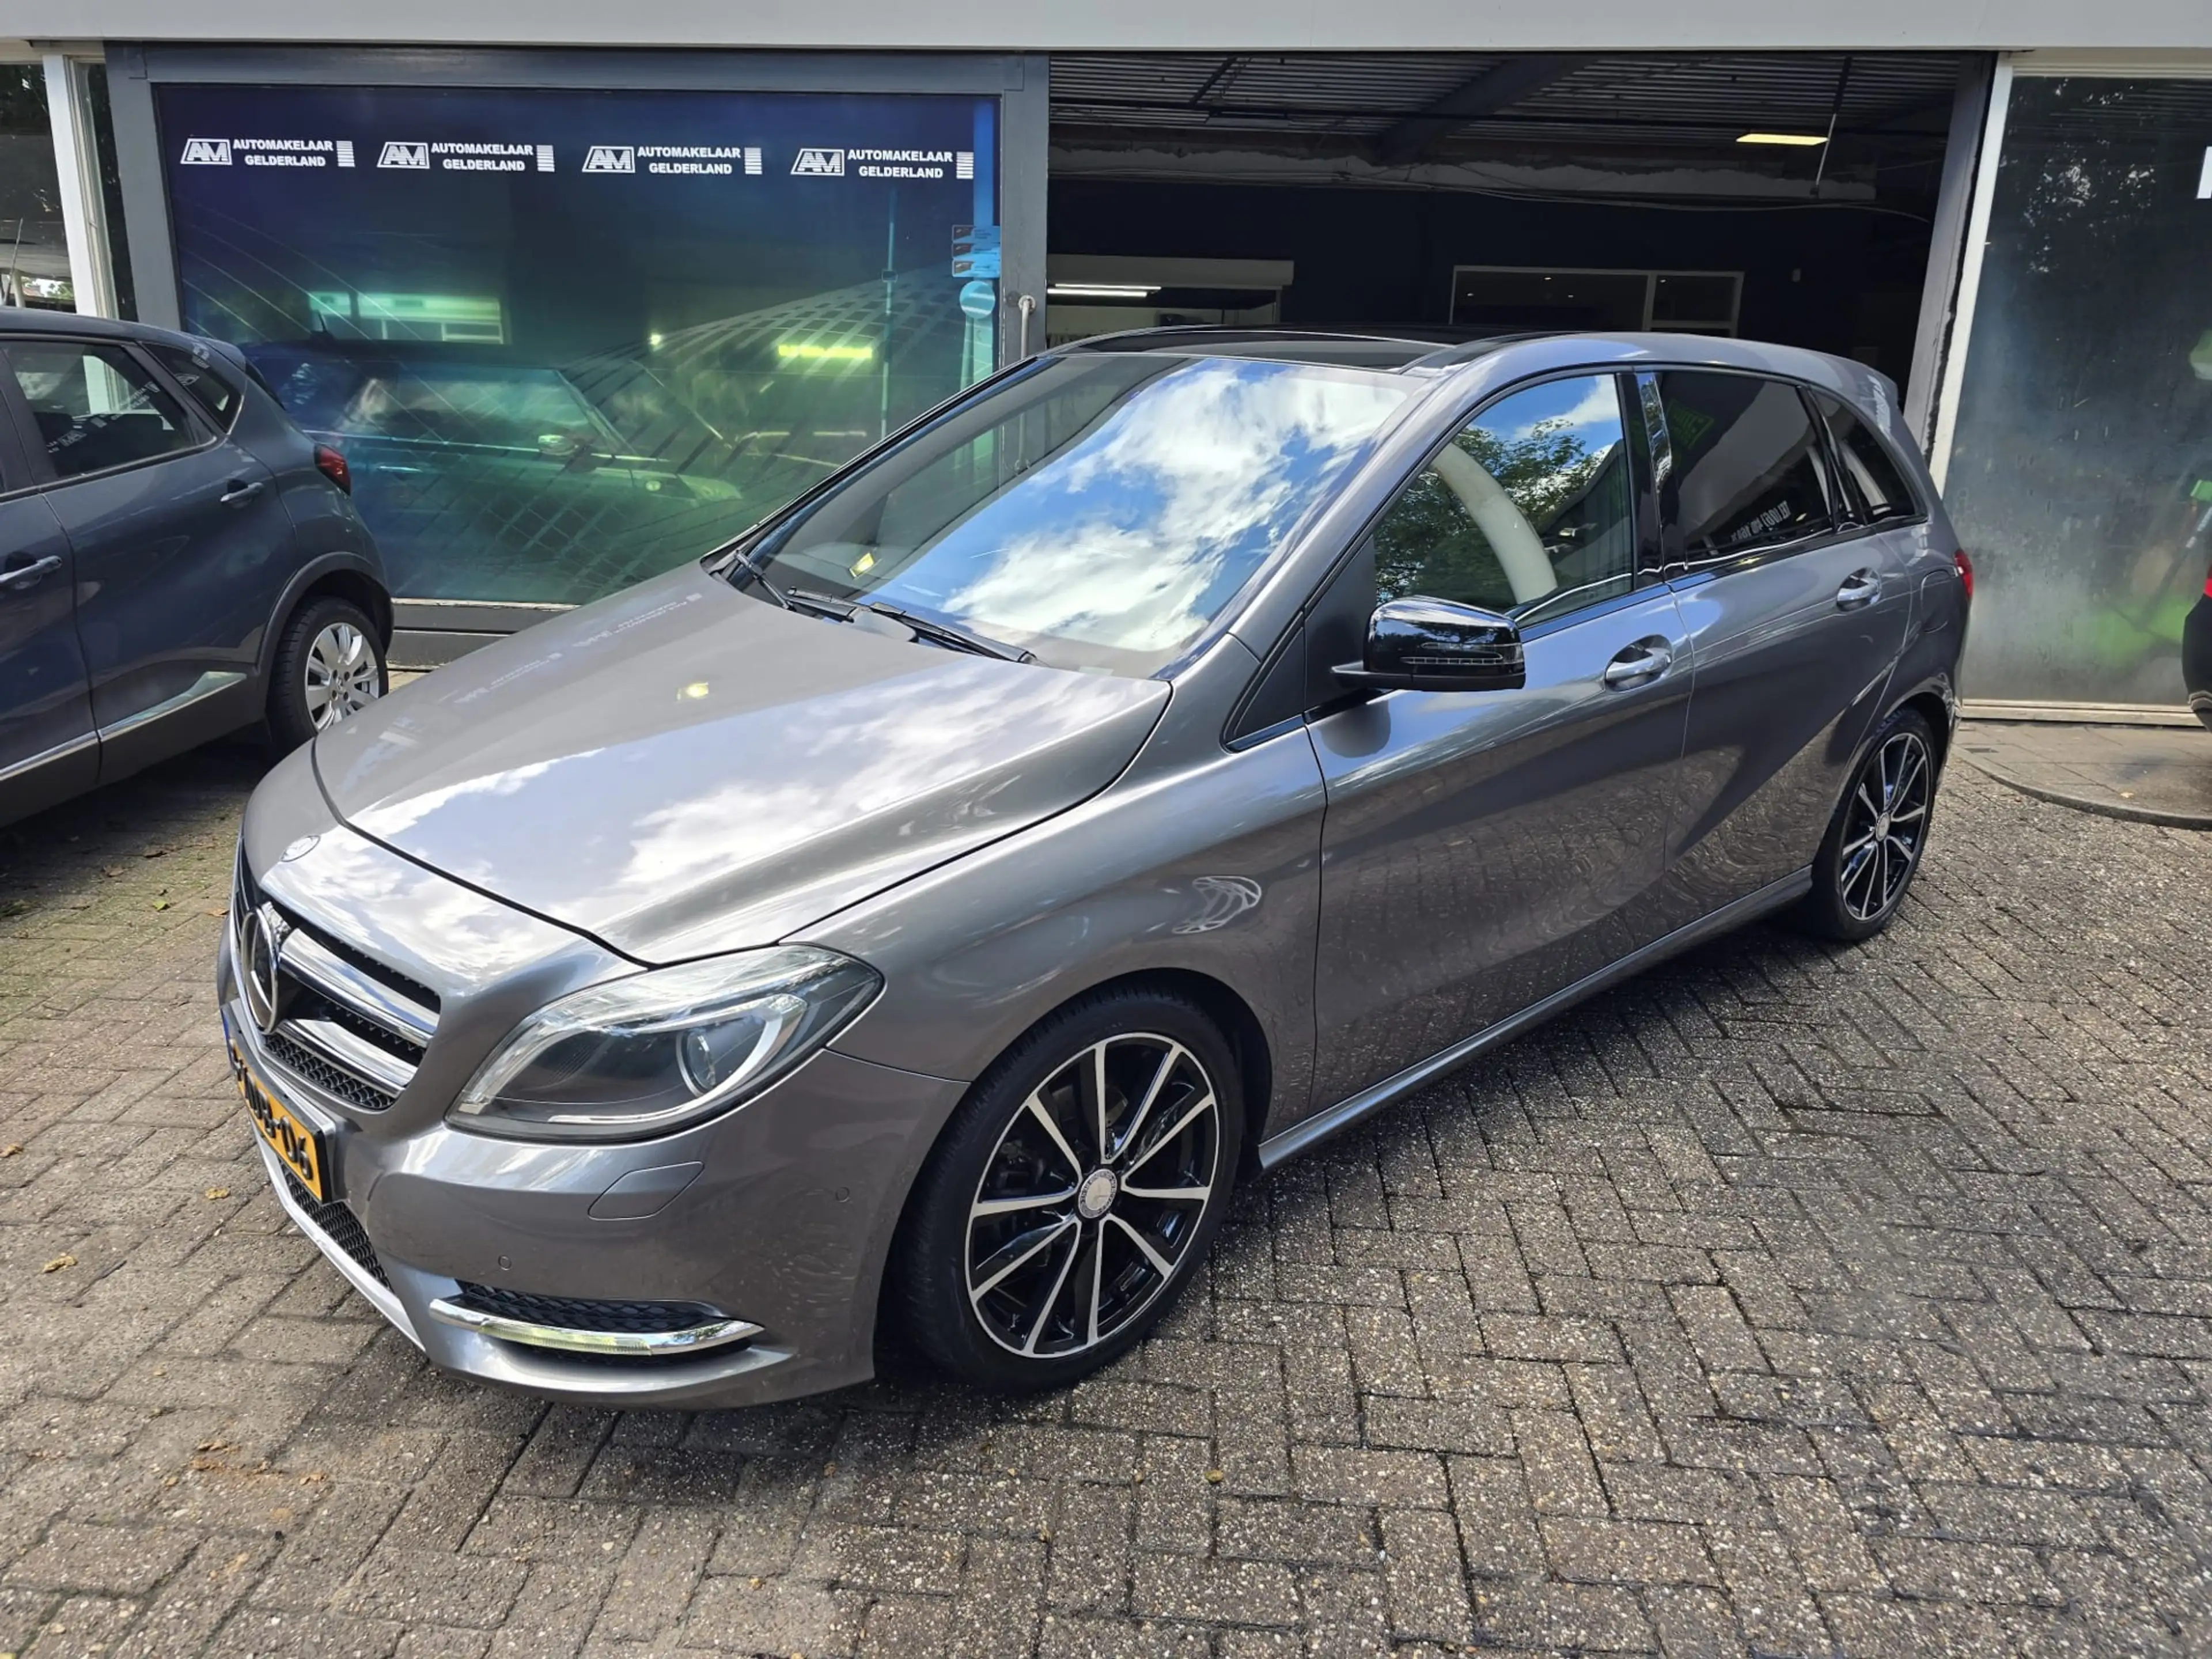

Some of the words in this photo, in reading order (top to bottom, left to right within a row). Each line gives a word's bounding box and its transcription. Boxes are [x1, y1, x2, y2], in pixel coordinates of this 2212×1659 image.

[233, 139, 334, 151] AUTOMAKELAAR
[431, 142, 533, 156] AUTOMAKELAAR
[637, 146, 741, 158] AUTOMAKELAAR
[847, 149, 953, 162] AUTOMAKELAAR
[244, 155, 326, 166] GELDERLAND
[442, 158, 525, 171] GELDERLAND
[649, 162, 732, 175] GELDERLAND
[858, 165, 944, 178] GELDERLAND
